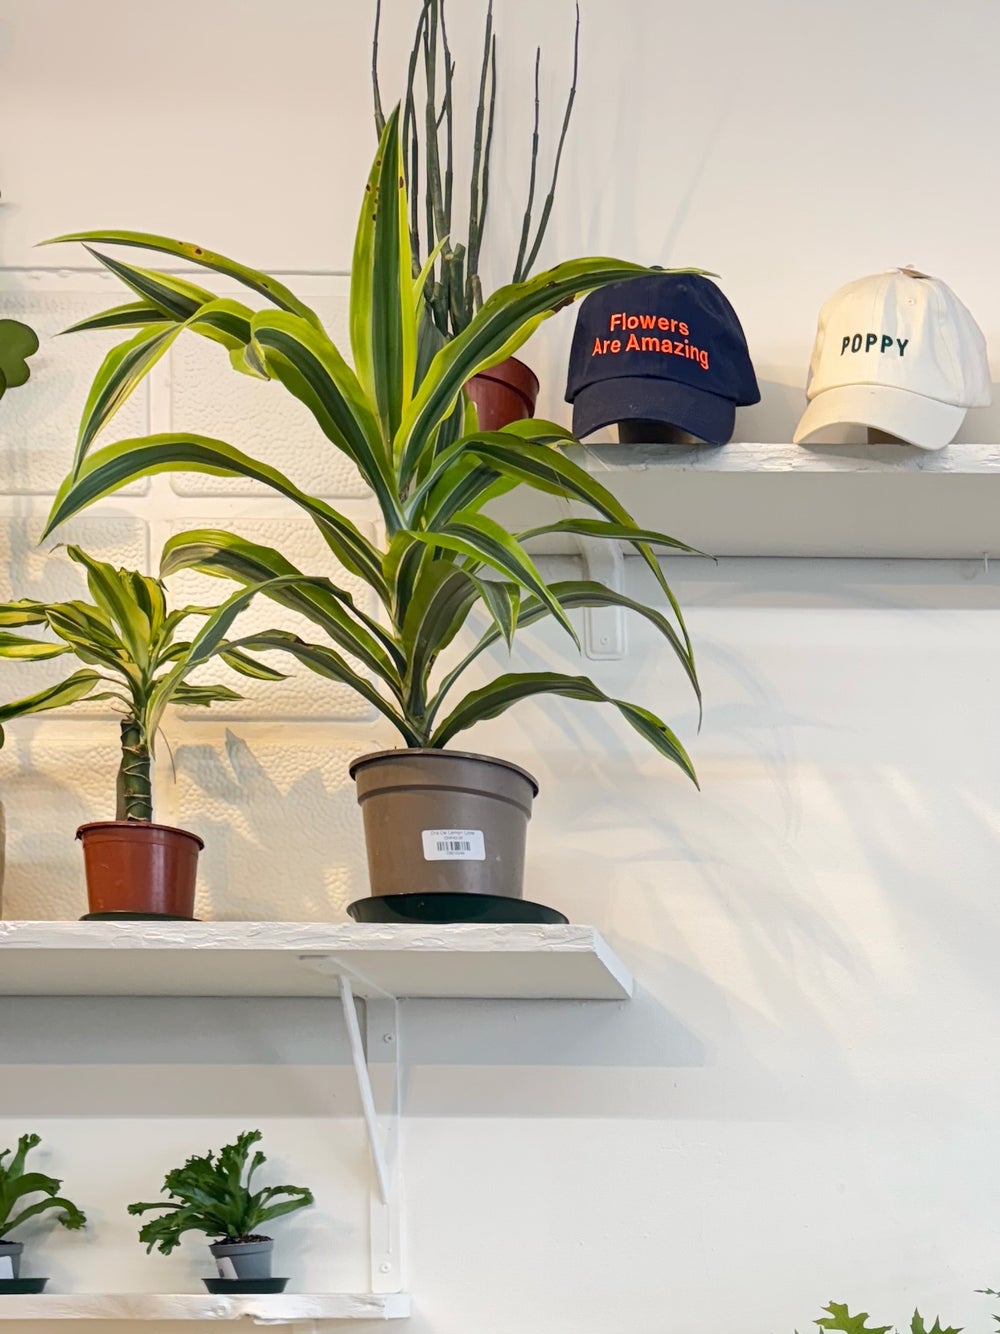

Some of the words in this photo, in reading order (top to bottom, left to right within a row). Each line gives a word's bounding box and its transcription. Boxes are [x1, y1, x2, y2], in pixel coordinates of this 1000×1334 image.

[610, 312, 690, 336] Flowers
[591, 337, 621, 356] Are
[625, 333, 709, 370] Amazing
[840, 332, 909, 357] POPPY
